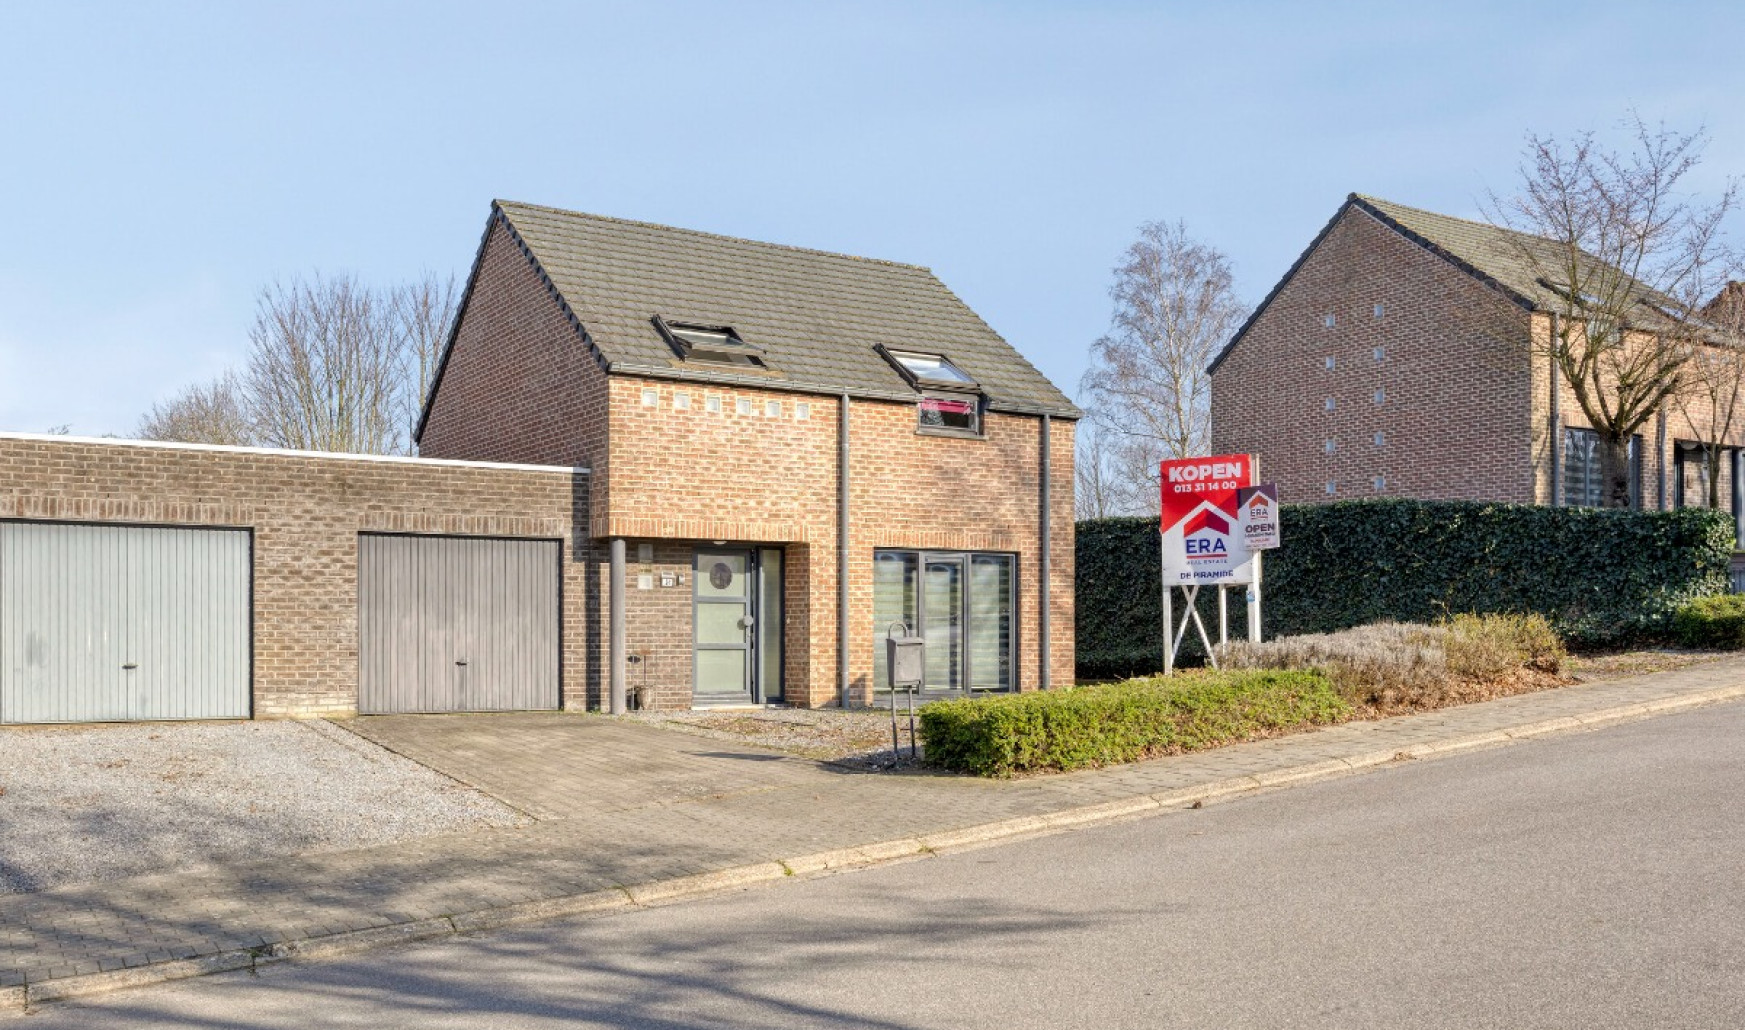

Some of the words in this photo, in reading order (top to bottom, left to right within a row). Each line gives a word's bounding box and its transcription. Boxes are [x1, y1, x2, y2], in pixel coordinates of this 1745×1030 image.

[1168, 462, 1241, 483] KOPEN
[1174, 484, 1192, 493] 013
[1195, 483, 1205, 491] 31
[1207, 482, 1219, 490] 14
[1222, 481, 1237, 490] 00
[1250, 508, 1268, 517] ERA
[1245, 523, 1275, 532] OPEN
[1186, 538, 1226, 553] ERA
[1180, 572, 1191, 580] DE
[1193, 570, 1234, 579] PIRAMIDE
